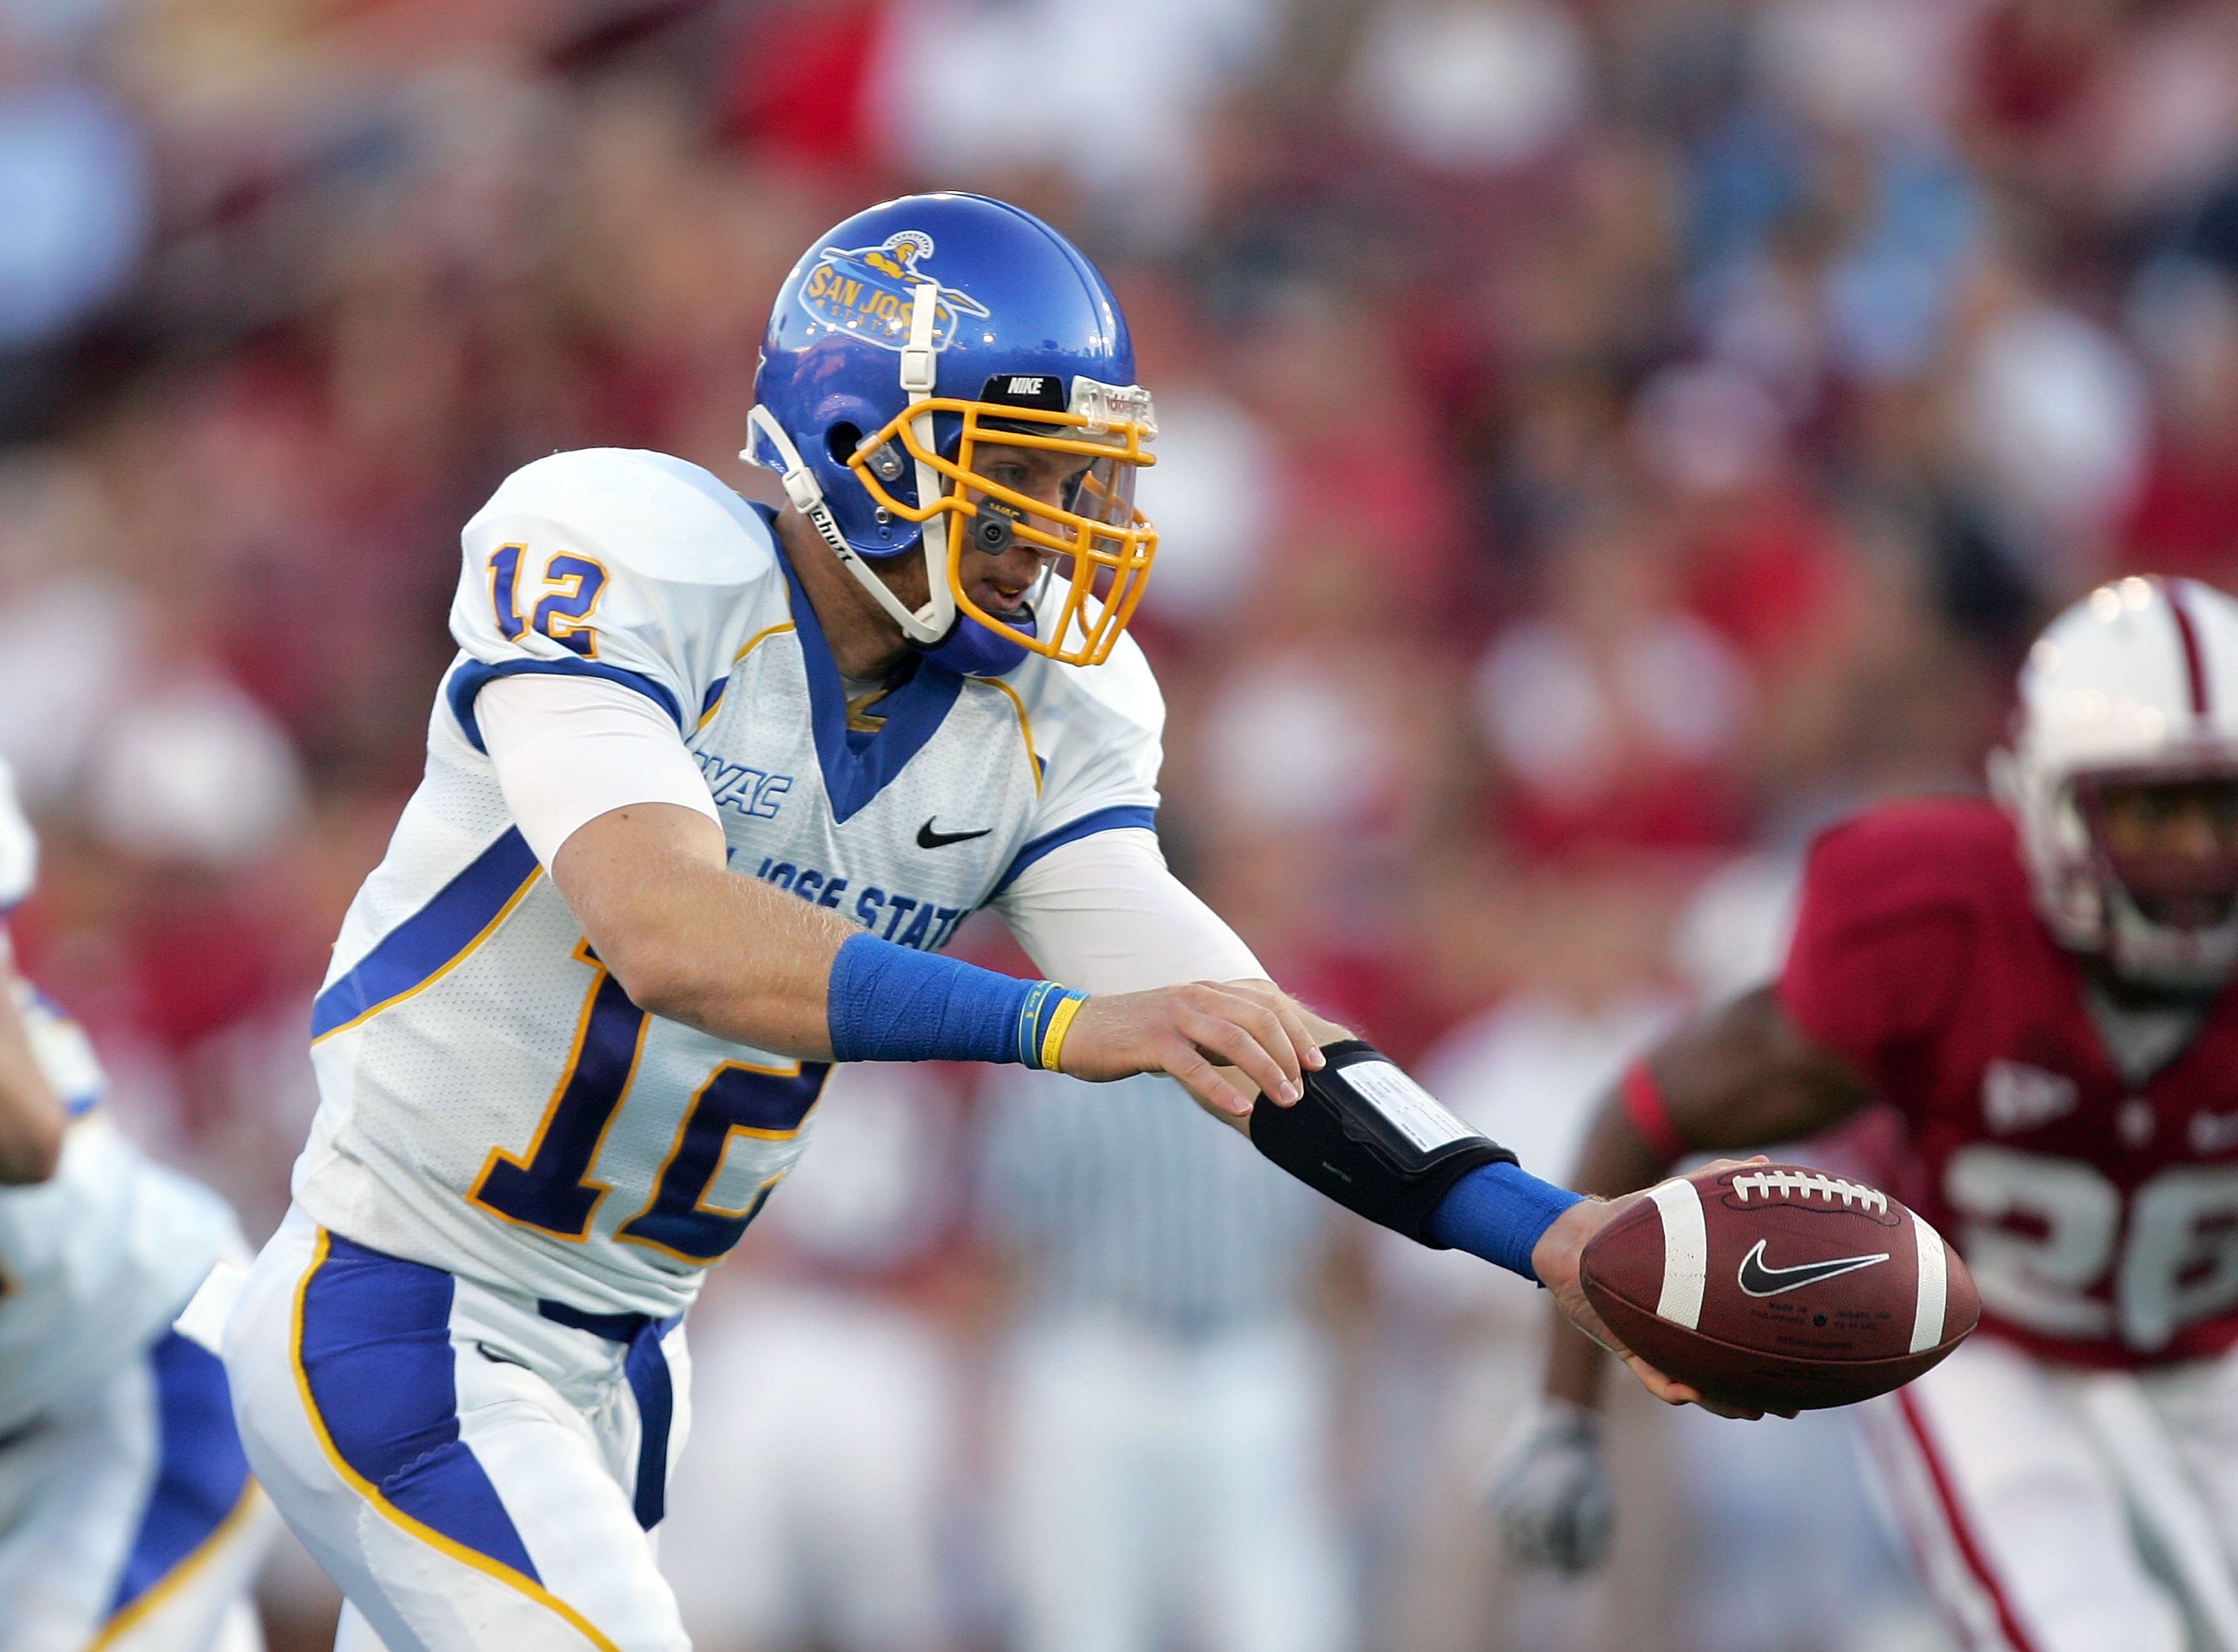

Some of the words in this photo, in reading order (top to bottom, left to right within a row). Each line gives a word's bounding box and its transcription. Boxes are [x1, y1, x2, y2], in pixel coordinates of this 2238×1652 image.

[808, 266, 864, 307] SAN
[859, 289, 947, 328] JOS
[1008, 377, 1044, 395] NIKE
[486, 542, 610, 659] 12
[465, 936, 836, 1266] 12
[1944, 1144, 2238, 1351] 26
